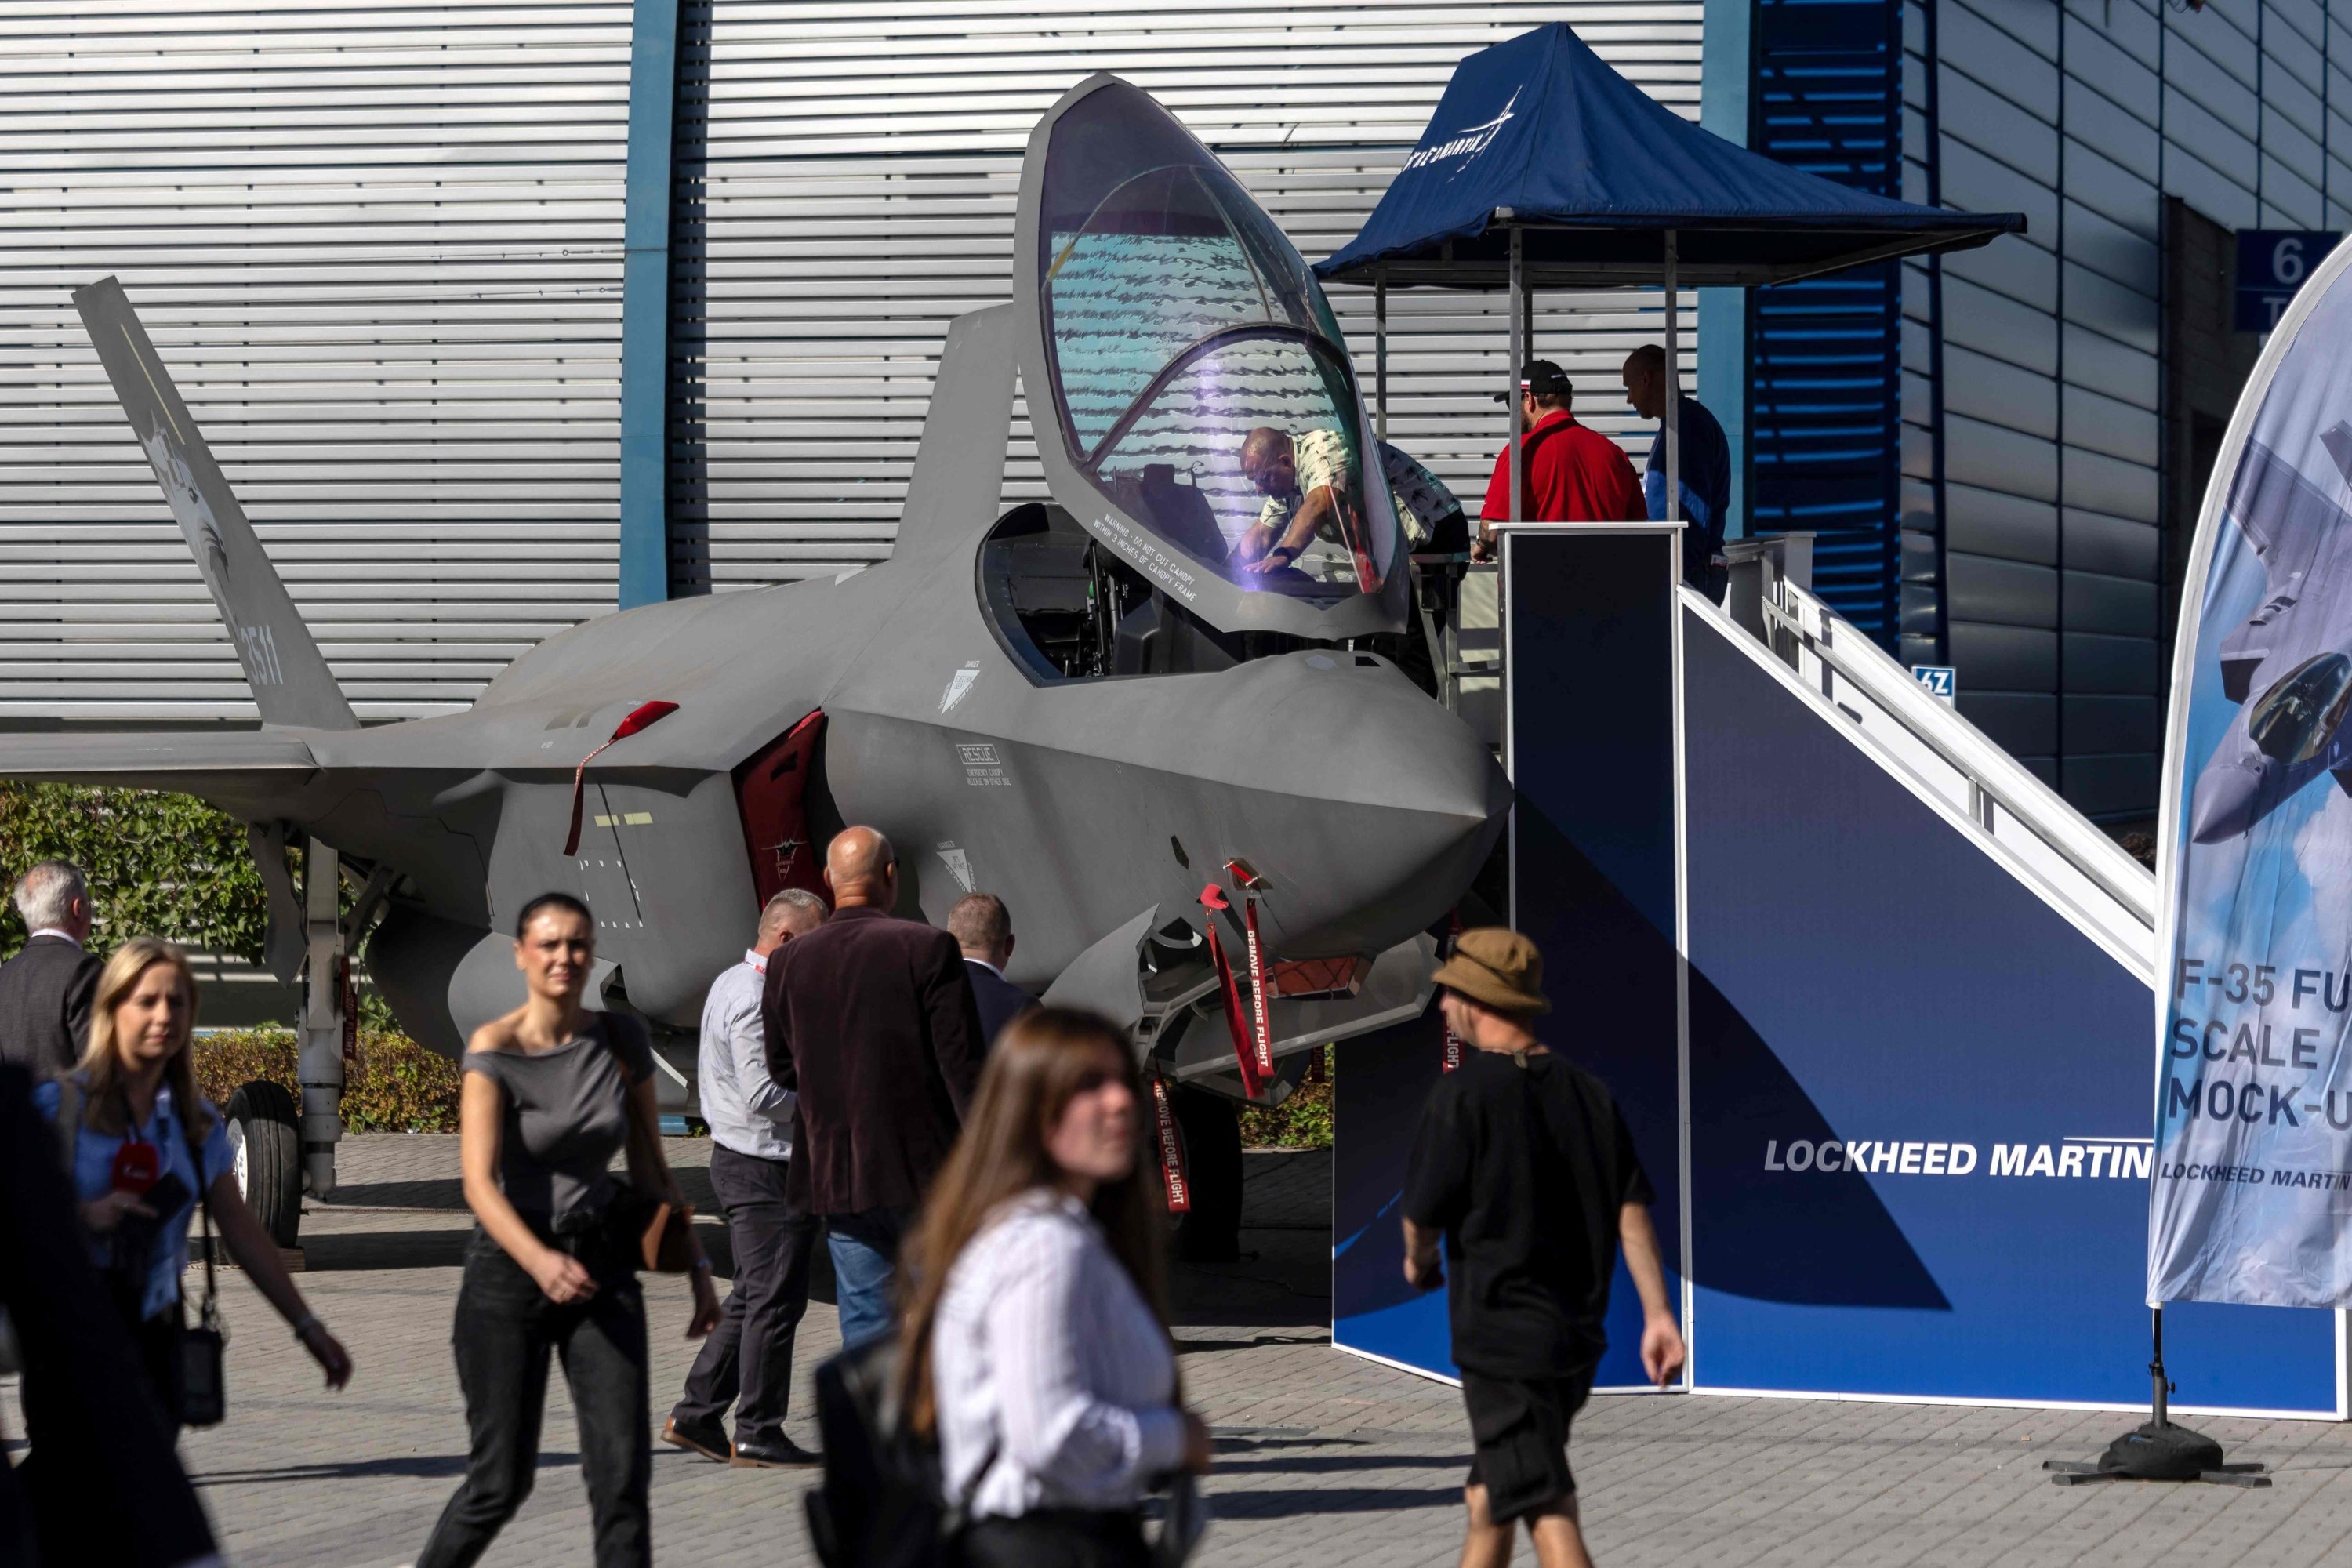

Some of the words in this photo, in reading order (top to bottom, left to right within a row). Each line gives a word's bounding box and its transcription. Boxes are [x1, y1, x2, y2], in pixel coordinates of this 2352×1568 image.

[2273, 238, 2304, 285] 6
[2261, 297, 2288, 328] T
[1094, 519, 1114, 539] WITHIN
[1112, 534, 1118, 543] 3
[1117, 539, 1139, 559] INCHES
[1138, 555, 1149, 564] OF
[1148, 562, 1174, 584] CANOPY
[1173, 581, 1197, 602] FRAME
[1104, 514, 1130, 538] WARNING
[1133, 536, 1143, 547] DO
[1143, 543, 1156, 557] NOT
[1155, 554, 1169, 568] CUT
[1169, 564, 1196, 586] CANOPY
[240, 625, 284, 686] 3511
[1920, 671, 1950, 694] 6Z
[961, 747, 995, 762] RESCUE
[1247, 930, 1259, 977] REMOVE
[1253, 980, 1264, 1025] BEFORE
[2176, 958, 2277, 1007] F-35
[2292, 968, 2351, 1014] FU
[1257, 1026, 1269, 1067] FLIGHT
[2170, 1018, 2321, 1070] SCALE
[1155, 1084, 1171, 1127] REMOVE
[2169, 1077, 2352, 1131] MOCK-U
[1162, 1128, 1178, 1167] BEFORE
[1764, 1140, 1977, 1175] LOCKHEED
[1989, 1142, 2154, 1178] MARTIN
[1168, 1168, 1185, 1204] FLIGHT
[2161, 1163, 2266, 1185] LOCKHEED
[2271, 1171, 2351, 1191] MARTIN
